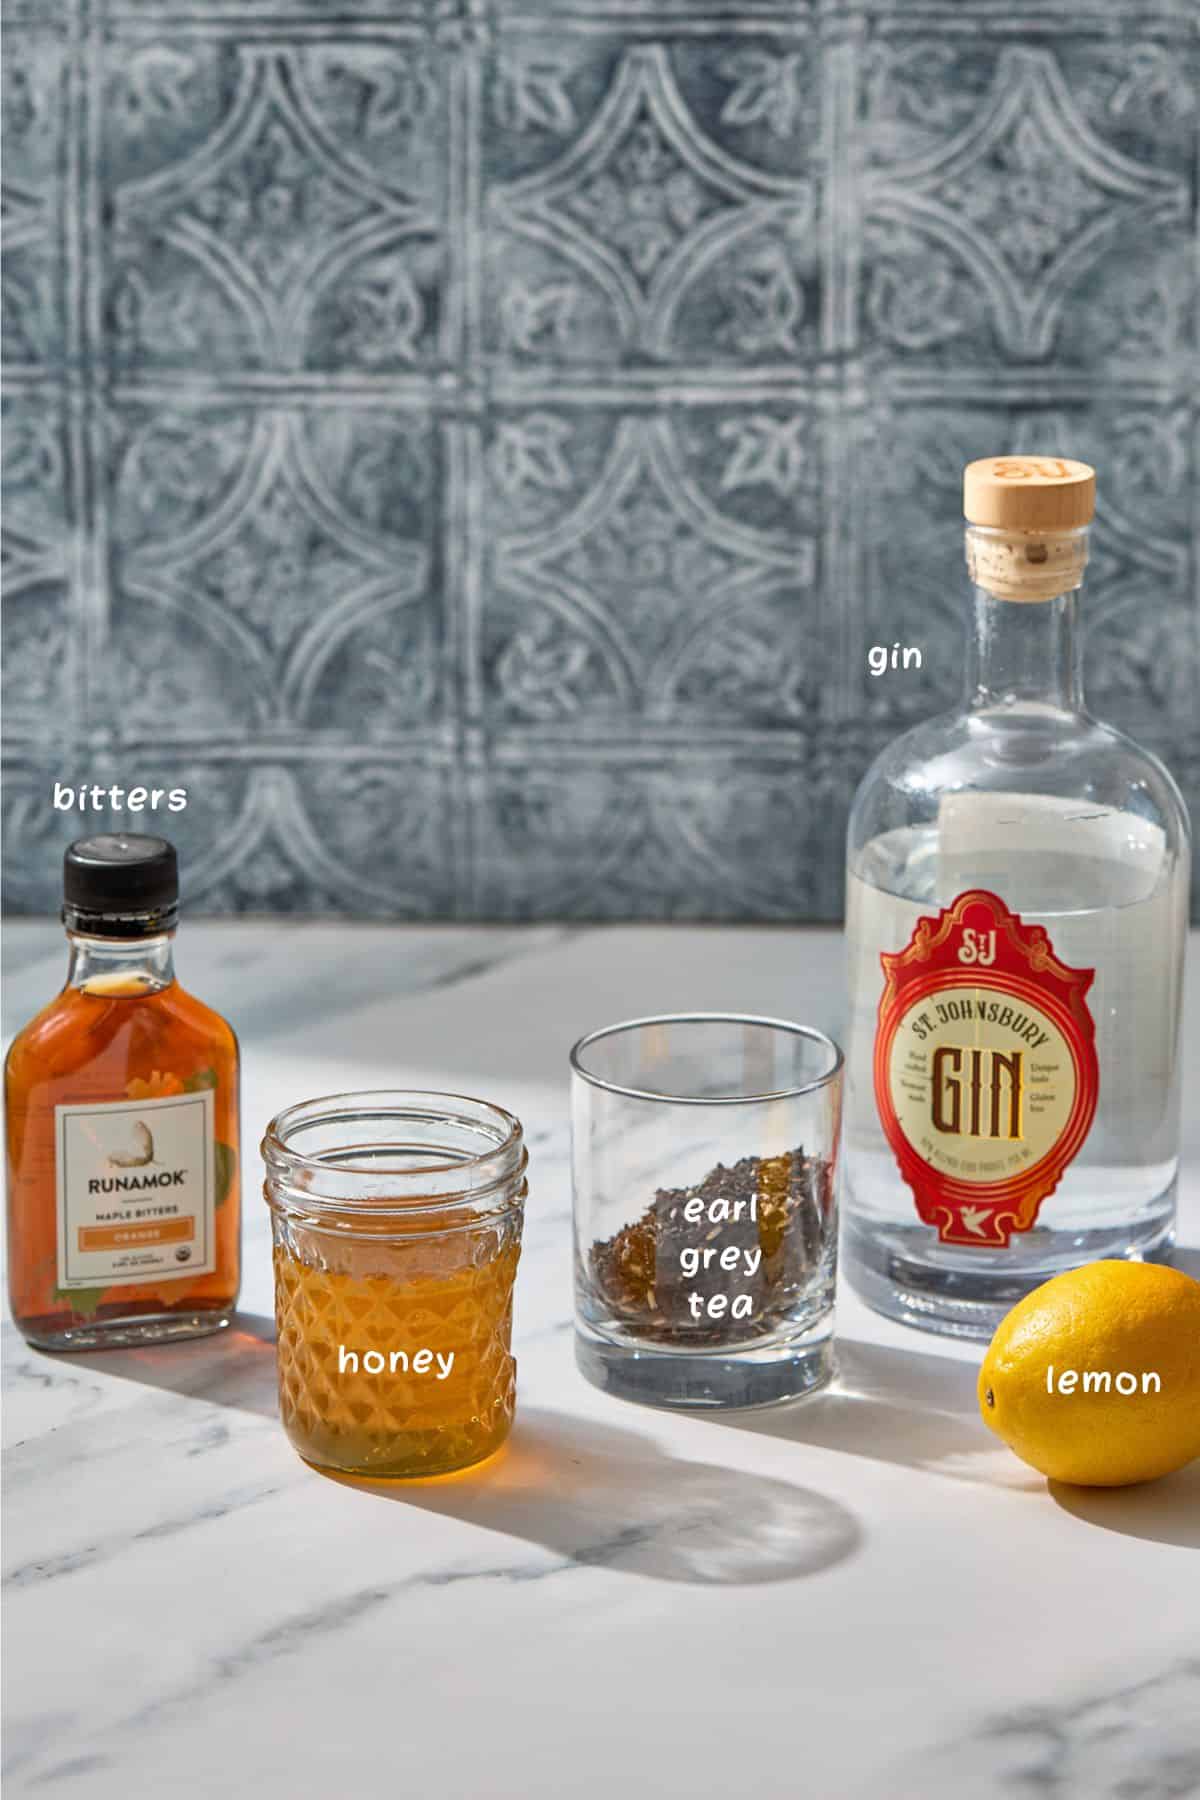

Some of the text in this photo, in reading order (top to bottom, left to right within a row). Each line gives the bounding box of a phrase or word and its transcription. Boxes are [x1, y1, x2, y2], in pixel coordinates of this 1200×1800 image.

[937, 999, 1051, 1051] JOHNSBURY
[931, 1047, 1024, 1140] GIN
[88, 1170, 185, 1195] RUNAMOK
[95, 1204, 179, 1222] MAPLE BITTERS
